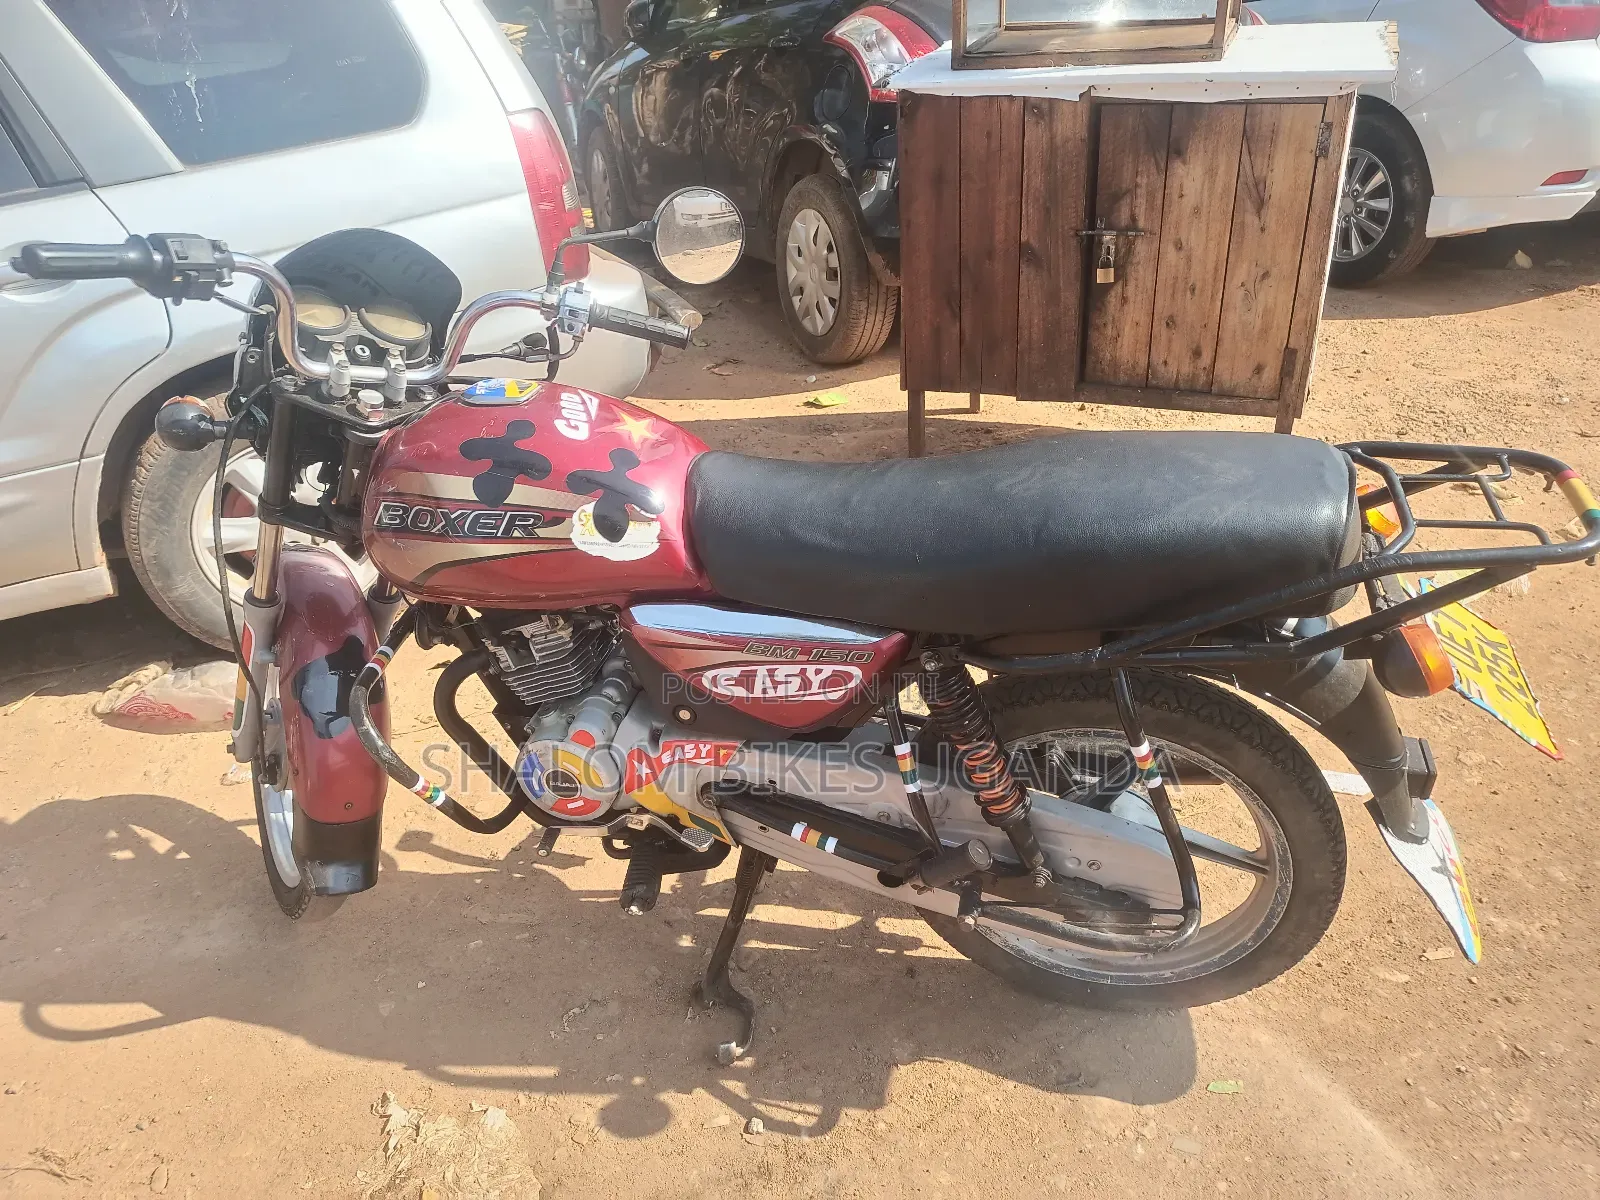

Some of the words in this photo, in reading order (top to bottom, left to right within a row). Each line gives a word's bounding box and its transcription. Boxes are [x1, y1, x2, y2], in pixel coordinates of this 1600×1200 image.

[374, 502, 544, 538] BOXER
[743, 640, 801, 660] BM
[807, 648, 875, 663] 150
[704, 665, 848, 699] EASY
[1471, 624, 1538, 720] 225K
[661, 743, 712, 764] EASY
